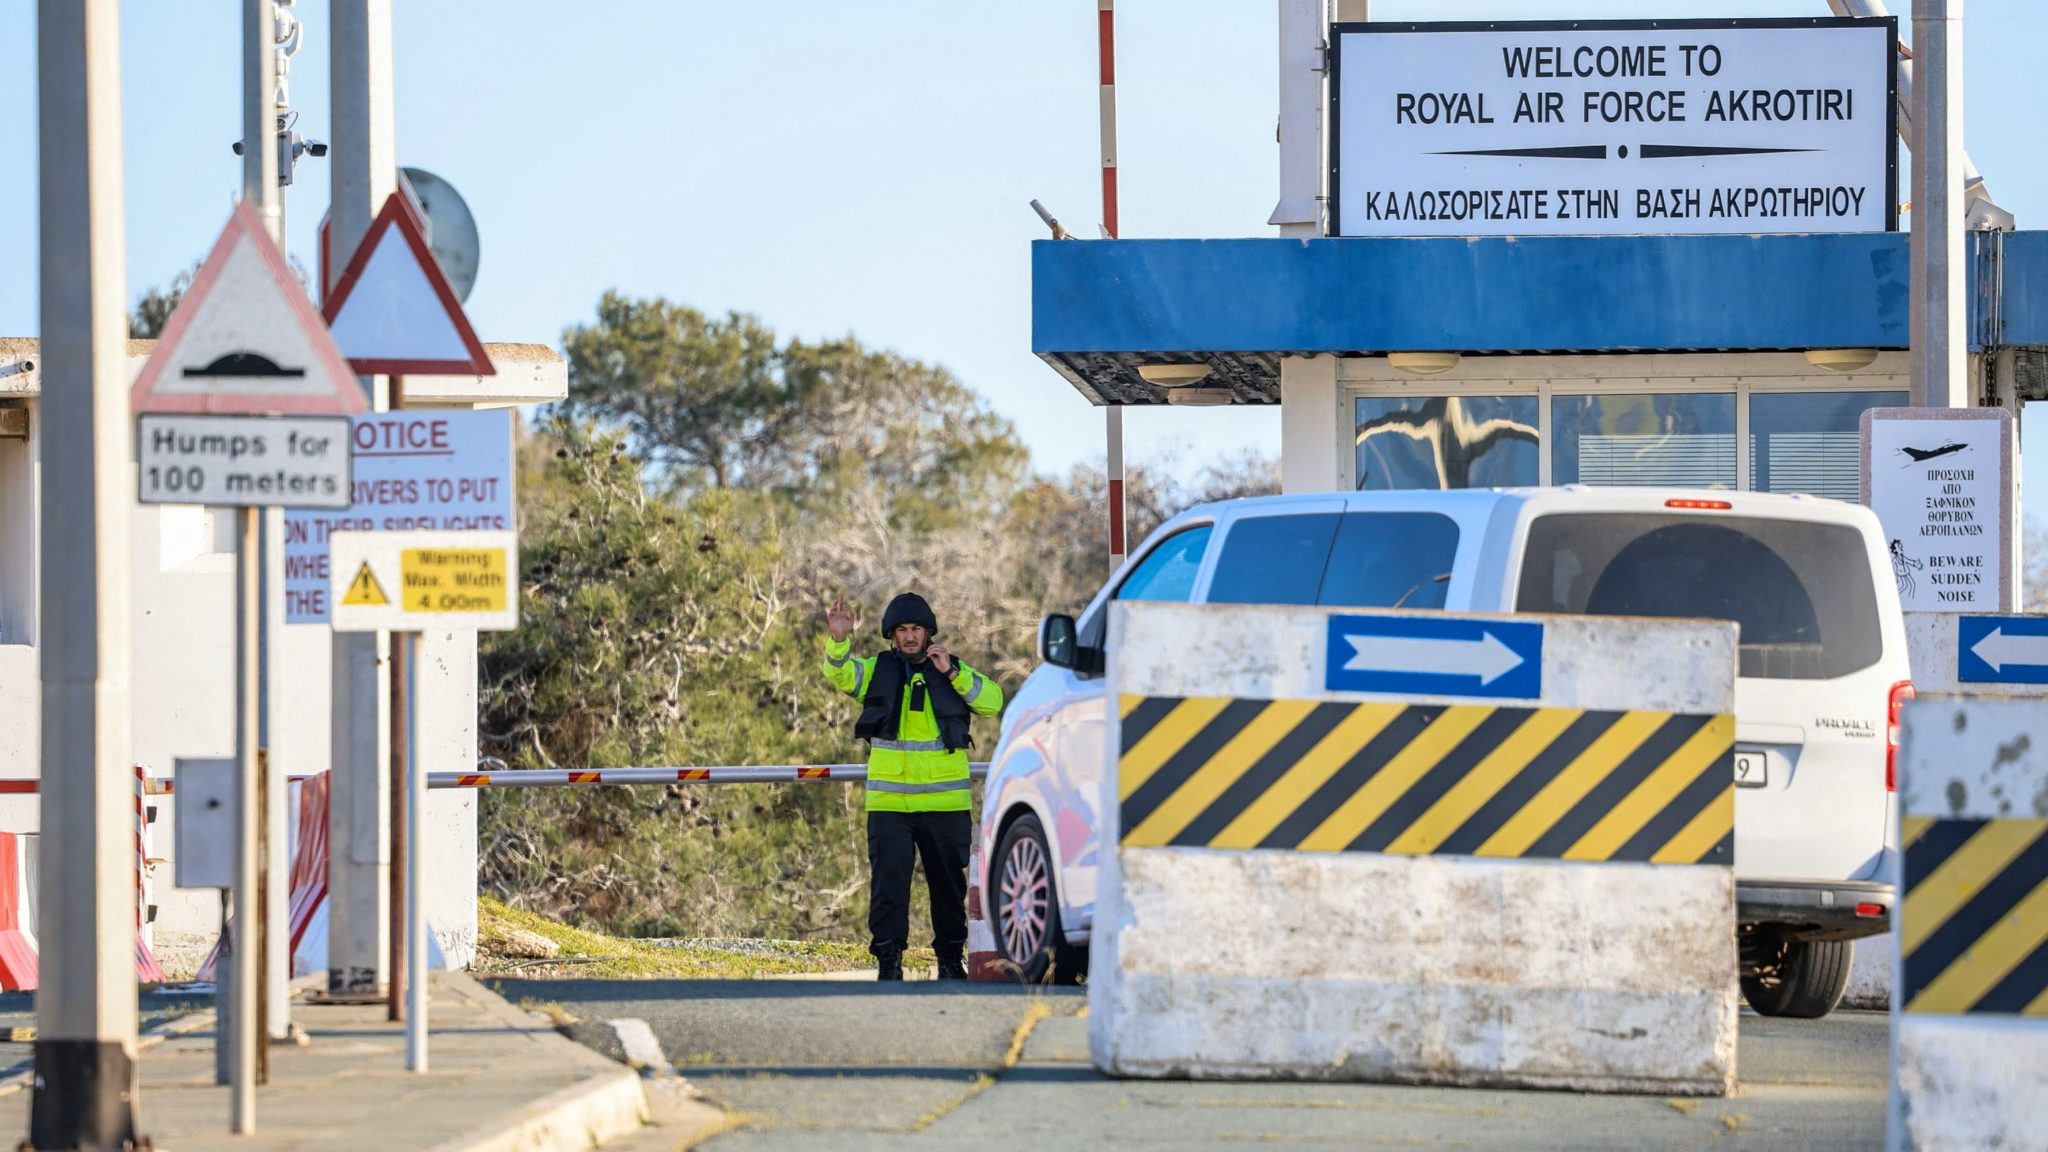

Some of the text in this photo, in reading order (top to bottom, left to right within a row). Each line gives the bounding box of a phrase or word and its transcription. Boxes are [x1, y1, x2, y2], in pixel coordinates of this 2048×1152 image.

[1502, 45, 1721, 78] WELCOME TO
[1397, 89, 1852, 124] ROYAL AIR FORCE AKROTIRI
[1367, 186, 1865, 220] ΚΑΛΩΣΟΡΙΣΑΤΕ ΣΤΗΝ ΒΑΣΗ ΑΚΡΩΤΗΡΙΟΥ
[153, 429, 330, 460] Humps for
[355, 420, 449, 448] OTICE
[150, 466, 337, 493] 100 meters
[1928, 470, 1974, 480] ΠΡΟΣΟΧΗ
[425, 477, 455, 503] TO
[458, 476, 499, 501] PUT
[1941, 484, 1961, 494] ΑΠΟ
[1926, 498, 1975, 508] ΞΑΦΝΙΚΟΝ
[1928, 511, 1973, 522] ΘΟΡΥΒΟΝ
[286, 555, 329, 578] WHE
[1930, 556, 1982, 567] BEWARE
[1931, 574, 1980, 584] SUDDEN
[286, 590, 324, 614] THE
[1938, 591, 1974, 601] NOISE
